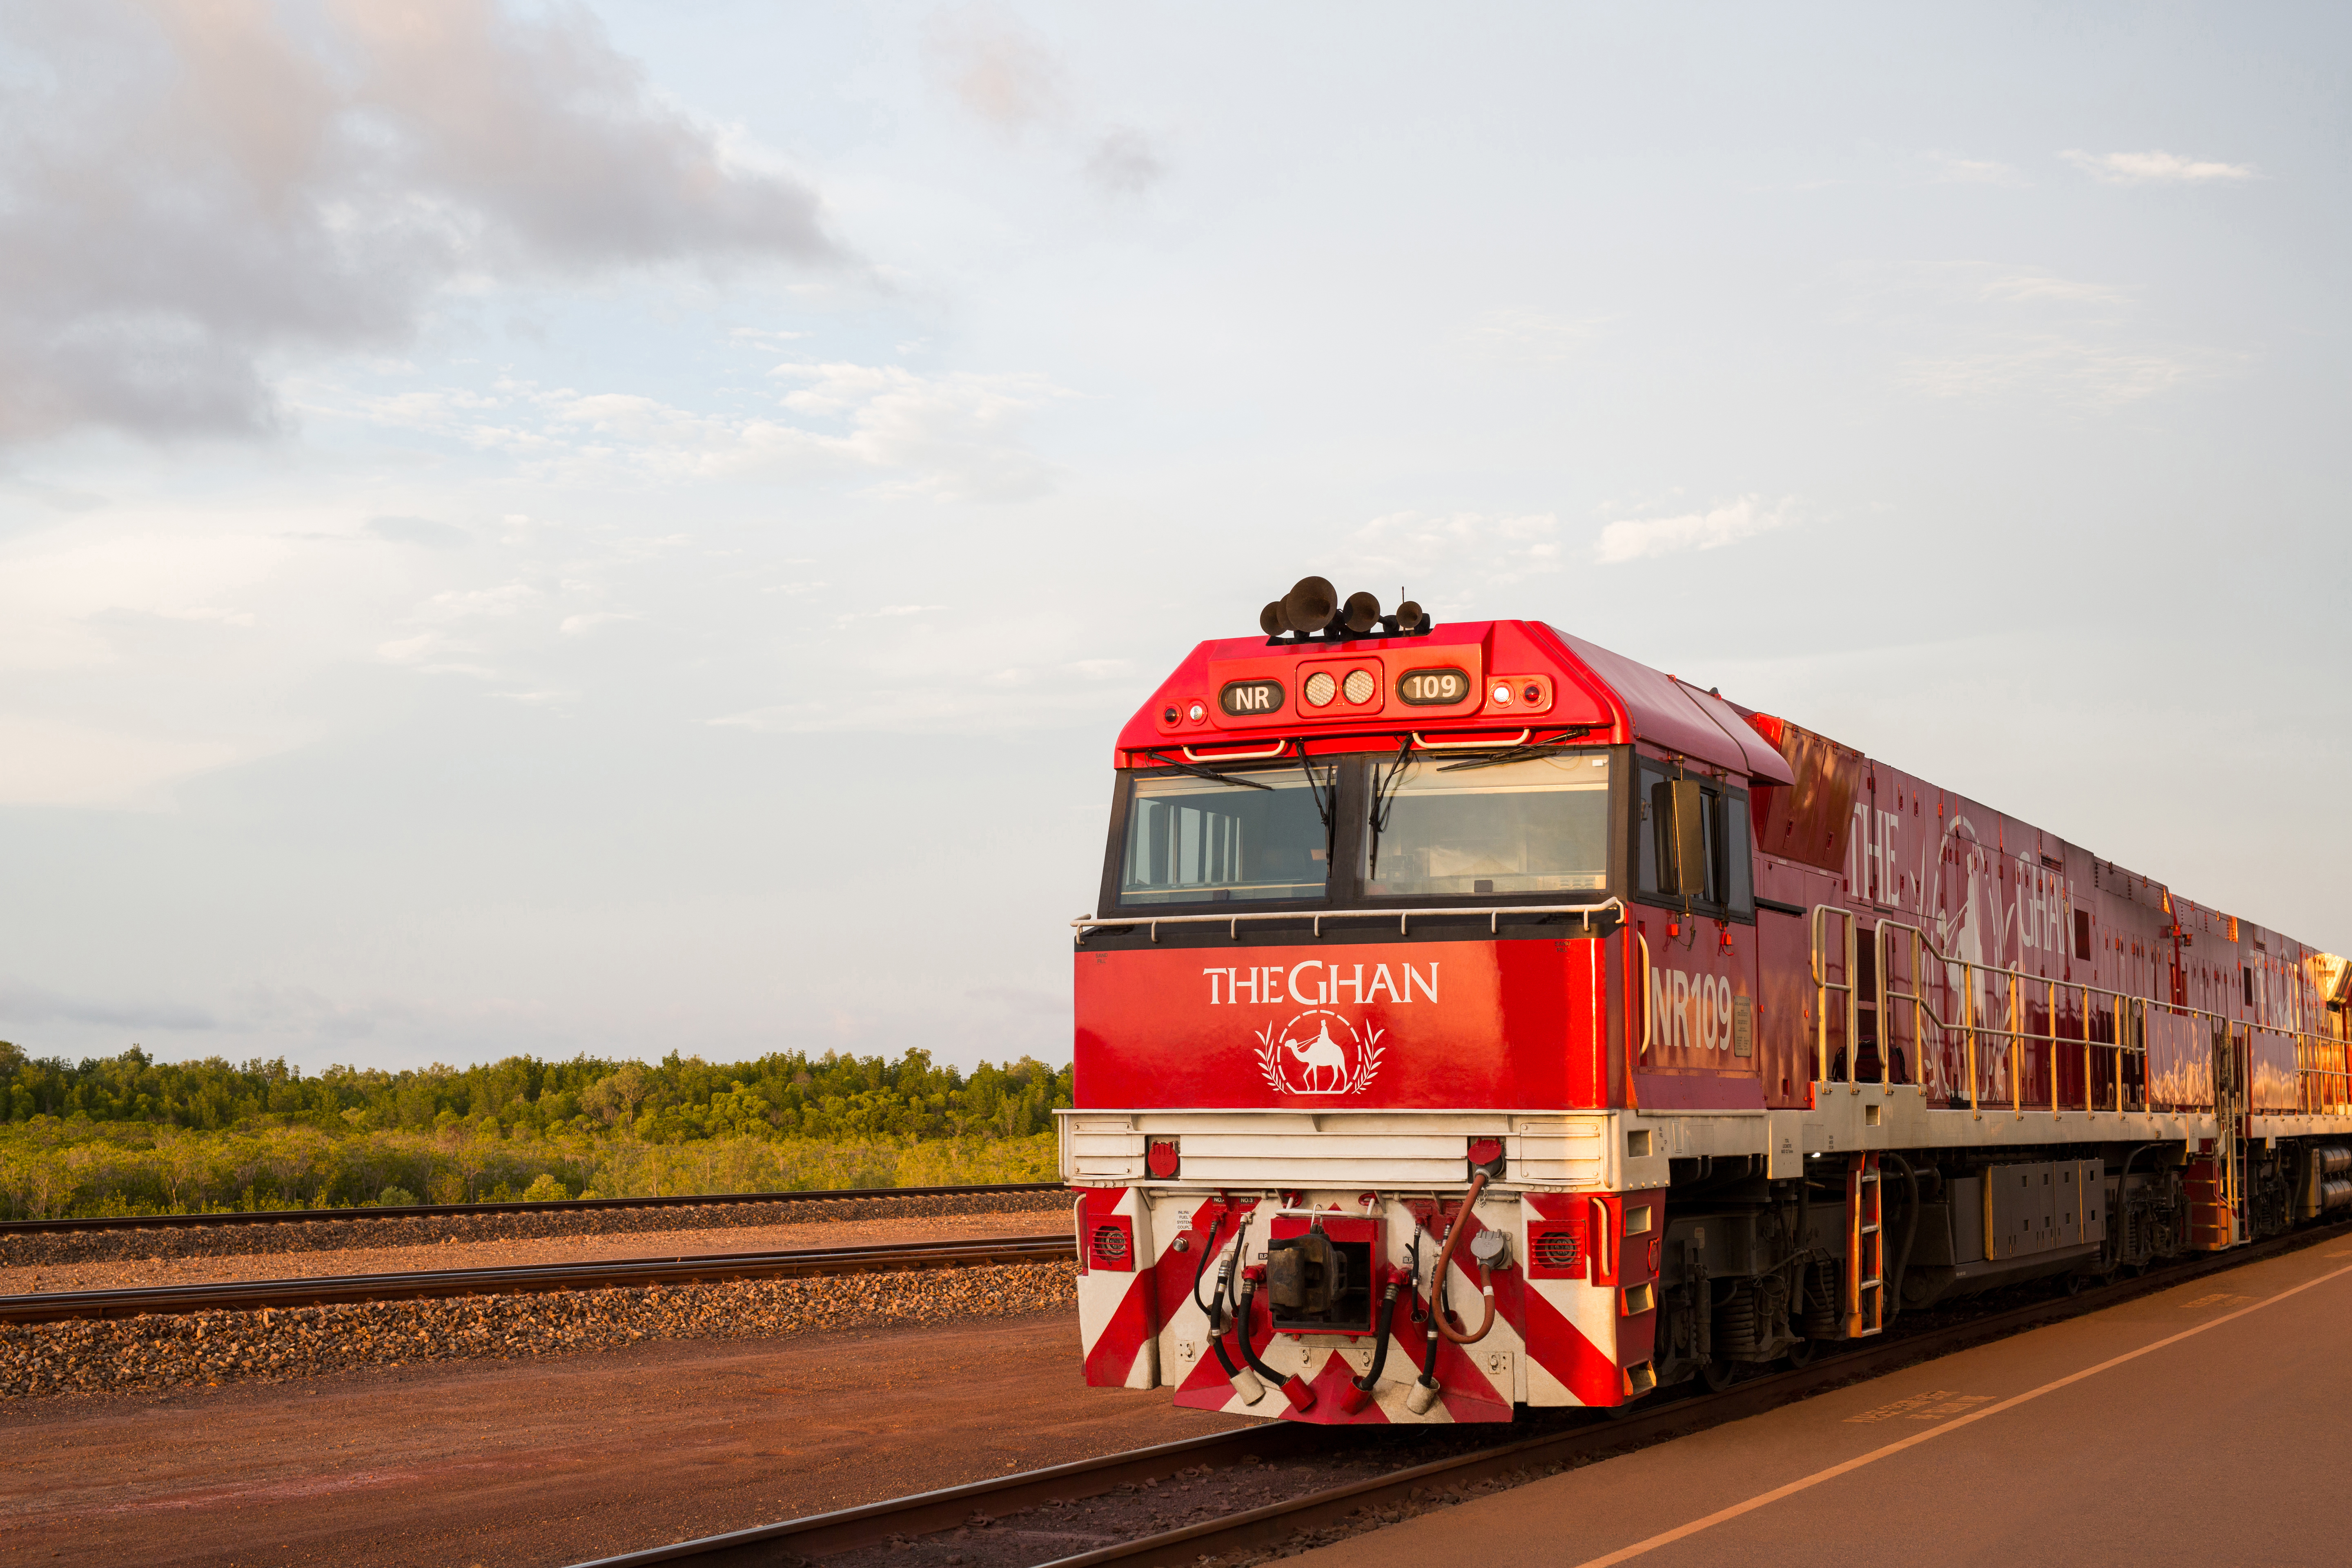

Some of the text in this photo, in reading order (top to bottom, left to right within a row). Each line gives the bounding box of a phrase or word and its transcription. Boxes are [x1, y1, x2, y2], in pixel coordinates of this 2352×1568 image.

[1236, 686, 1270, 710] NR
[1412, 675, 1456, 698] 109
[1851, 802, 2075, 961] THE GHAN
[1203, 960, 1440, 1006] THE GHAN
[1652, 967, 1732, 1051] NR109
